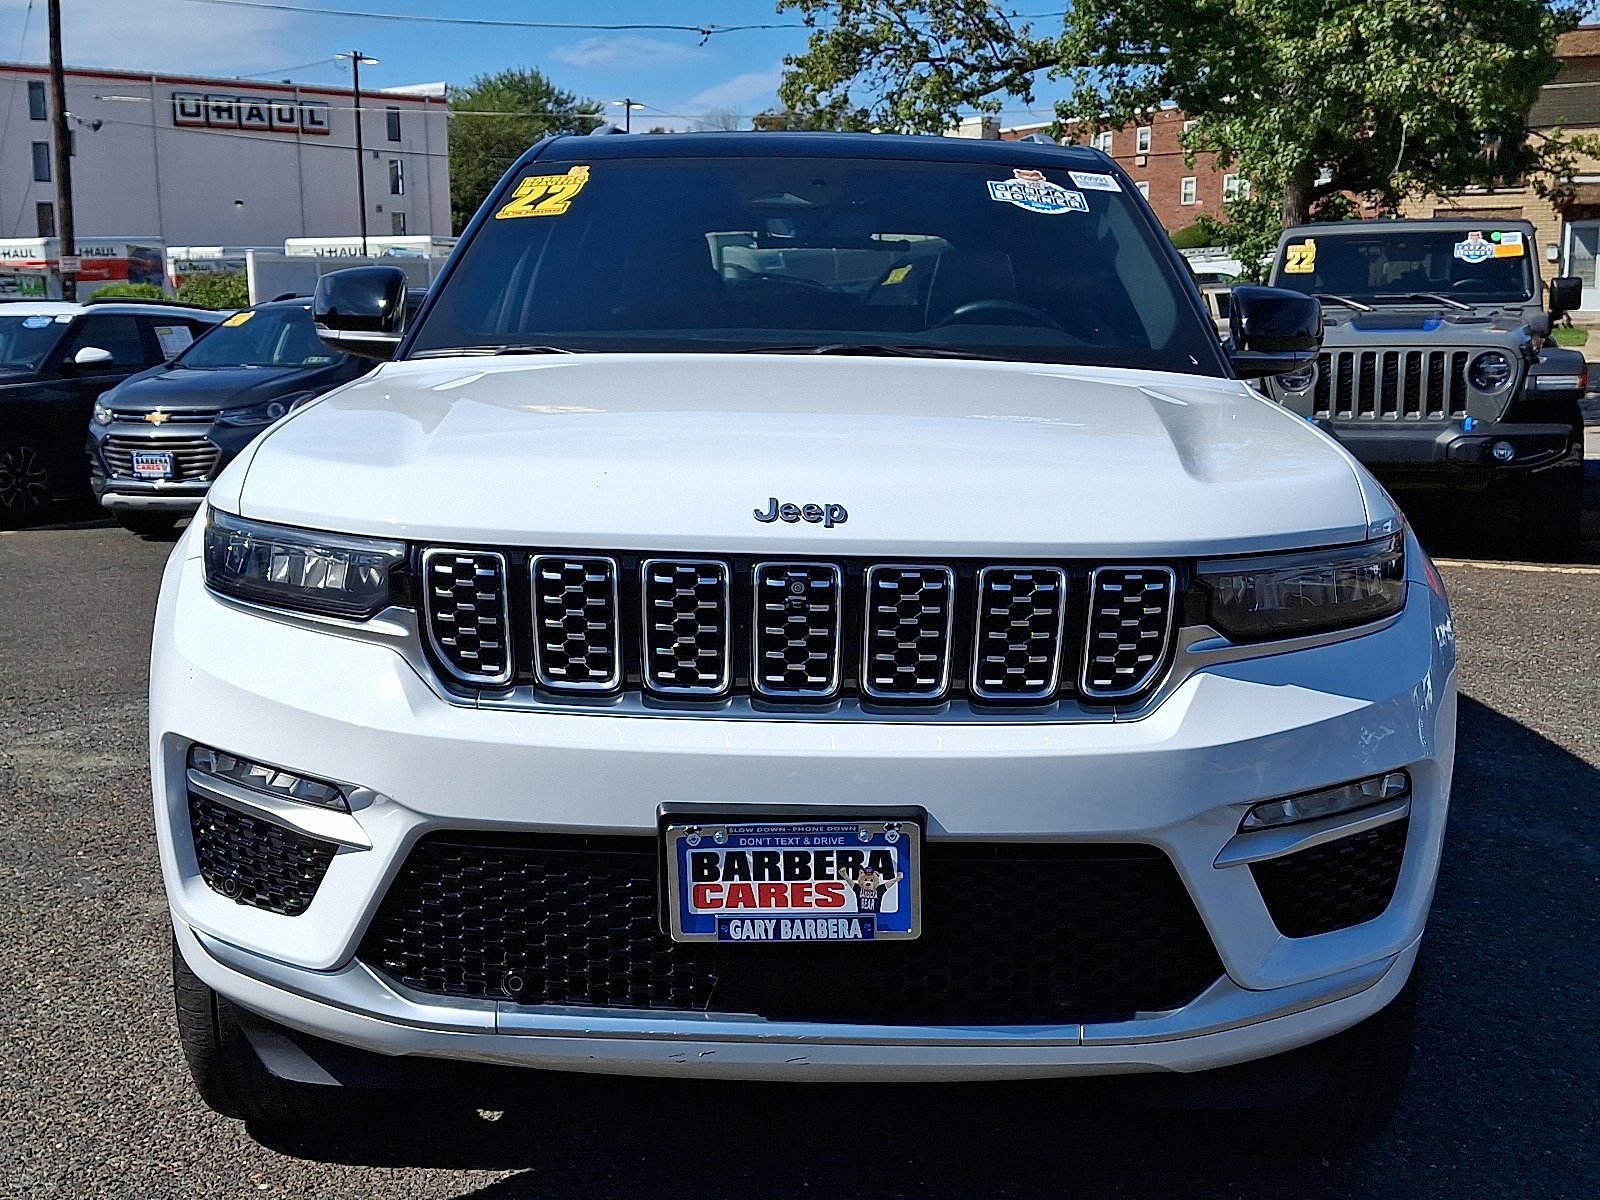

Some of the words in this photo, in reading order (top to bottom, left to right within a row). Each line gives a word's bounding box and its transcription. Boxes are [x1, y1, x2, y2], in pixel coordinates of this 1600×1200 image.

[500, 184, 581, 214] 22
[995, 184, 1079, 201] CARFAX
[753, 497, 848, 529] Jeep
[739, 837, 770, 846] DON'T
[775, 837, 800, 846] TEXT
[803, 837, 811, 845] &
[814, 837, 845, 845] DRIVE
[691, 850, 896, 882] BARBERA
[692, 882, 846, 909] CARES
[861, 898, 875, 910] BEAR
[729, 919, 776, 939] GARY
[780, 919, 862, 939] BARBERA
